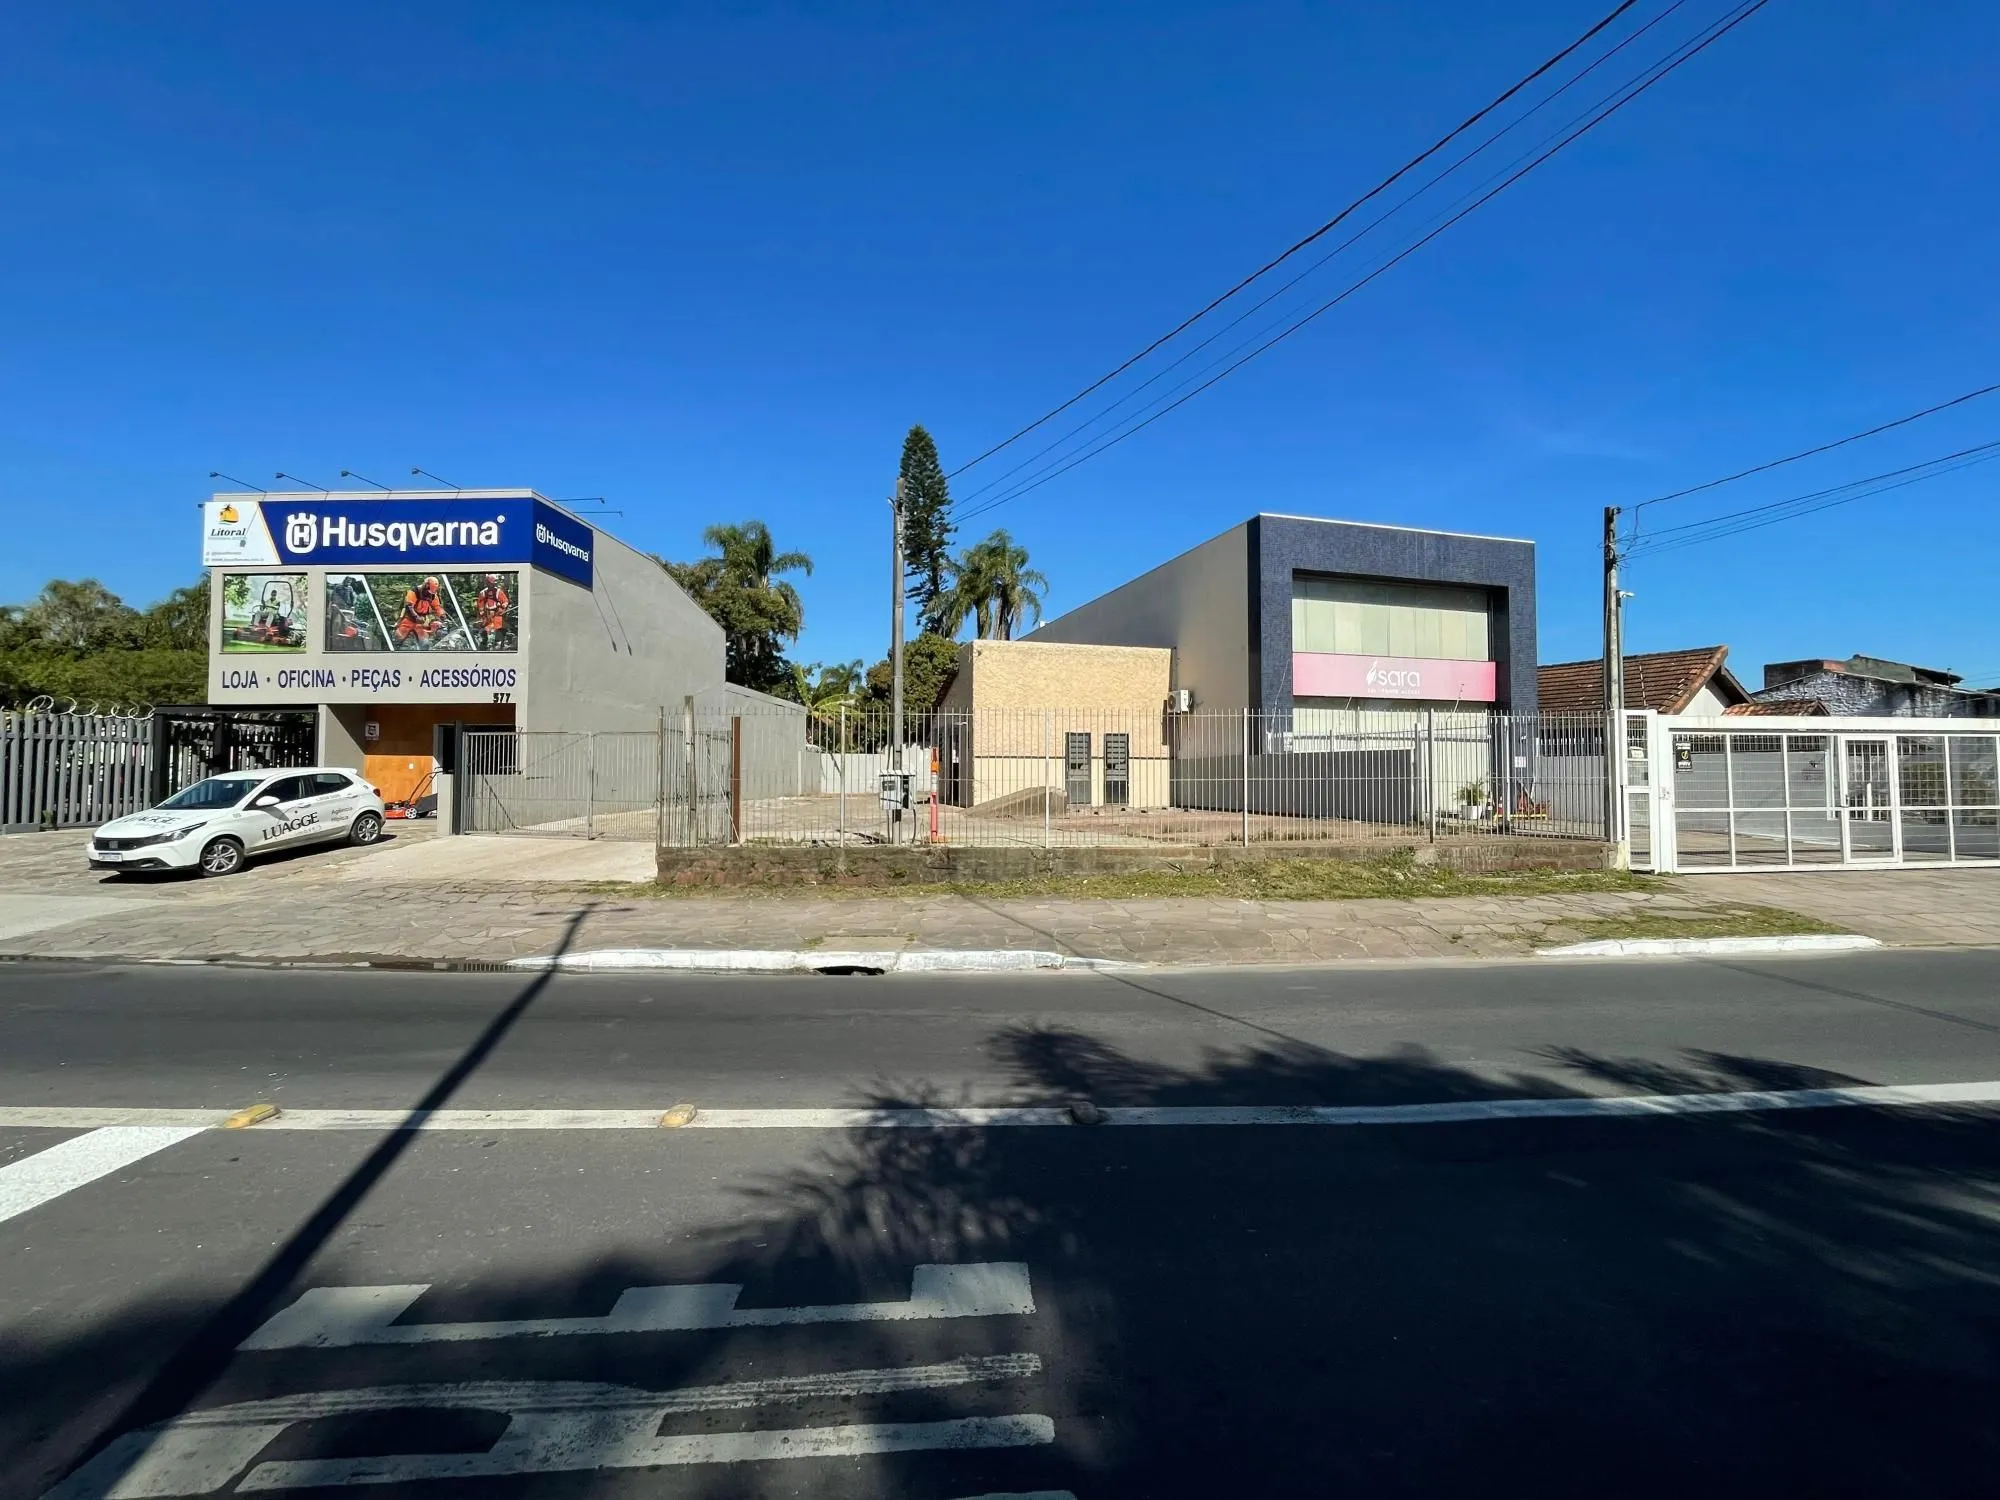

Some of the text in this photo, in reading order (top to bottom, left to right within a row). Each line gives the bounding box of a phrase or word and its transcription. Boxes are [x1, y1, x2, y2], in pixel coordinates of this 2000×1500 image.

[210, 527, 246, 537] Litoral
[322, 516, 499, 552] Husqvarna
[546, 530, 589, 562] Husqvarna
[221, 663, 517, 692] LOJA OFICINA PEÇAS ACESSÓRIOS
[1377, 670, 1421, 687] sara
[493, 692, 511, 704] 577
[262, 812, 320, 840] LUAGGE
